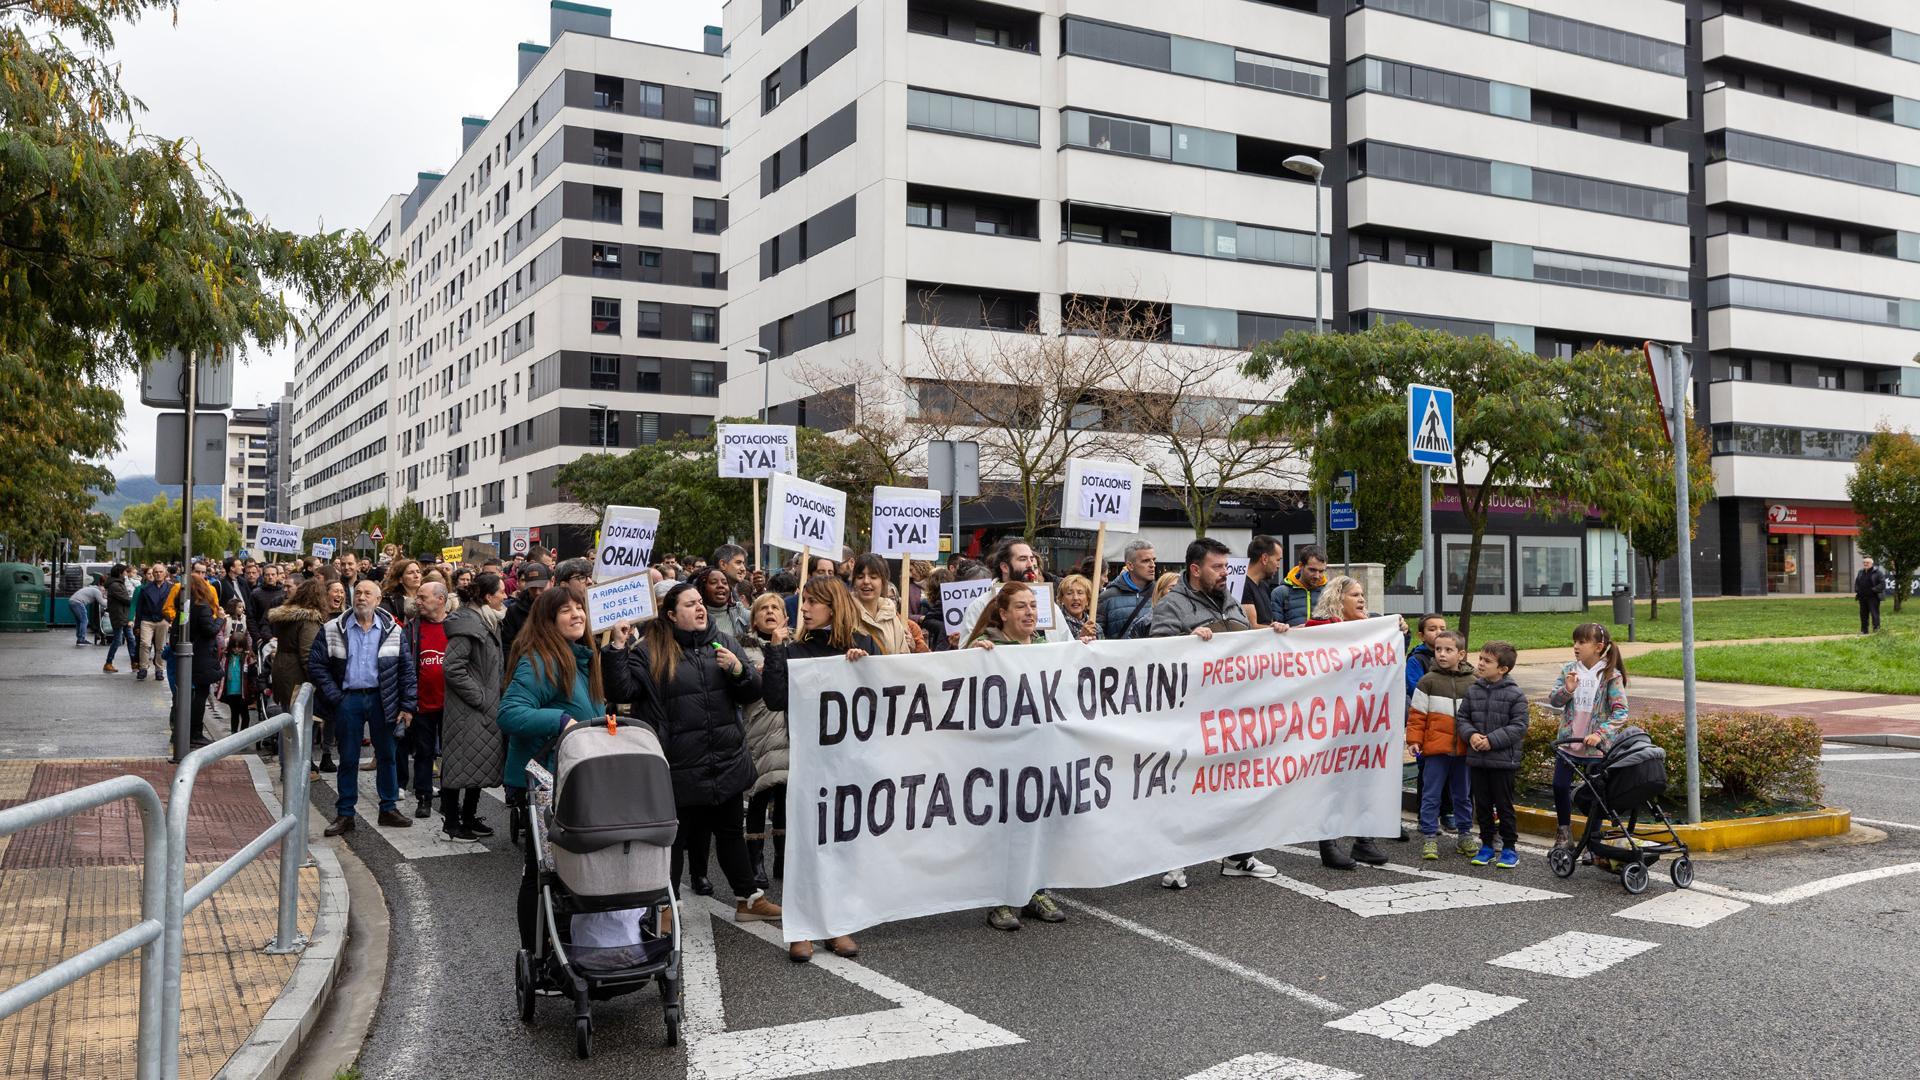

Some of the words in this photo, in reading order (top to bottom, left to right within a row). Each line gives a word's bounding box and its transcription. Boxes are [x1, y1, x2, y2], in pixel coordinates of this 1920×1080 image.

[724, 435, 788, 444] DOTACIONES
[738, 450, 776, 474] ¡YA!
[1082, 476, 1132, 490] DOTACIONES
[786, 492, 836, 518] DOTACIONES
[874, 506, 940, 518] DOTACIONES
[1090, 492, 1120, 518] ¡YA!
[262, 528, 298, 537] DOTAZIOAK
[794, 514, 825, 540] ¡YA!
[888, 523, 927, 549] ¡YA!
[260, 536, 297, 548] ORAIN!
[598, 606, 644, 623] ENGAÑA!!!
[602, 600, 616, 610] NO
[618, 596, 628, 606] SE
[630, 594, 639, 602] LE
[819, 668, 1066, 746] DOTAZIOAK
[1078, 662, 1188, 716] ORAIN!
[1201, 648, 1344, 686] PRESUPUESTOS
[1350, 642, 1398, 669] PARA
[1200, 684, 1392, 756] ERRIPAGAÑA
[1192, 742, 1389, 796] AURREKONTUETAN
[818, 754, 1113, 846] ¡DOTACIONES
[1132, 748, 1188, 800] YA!
